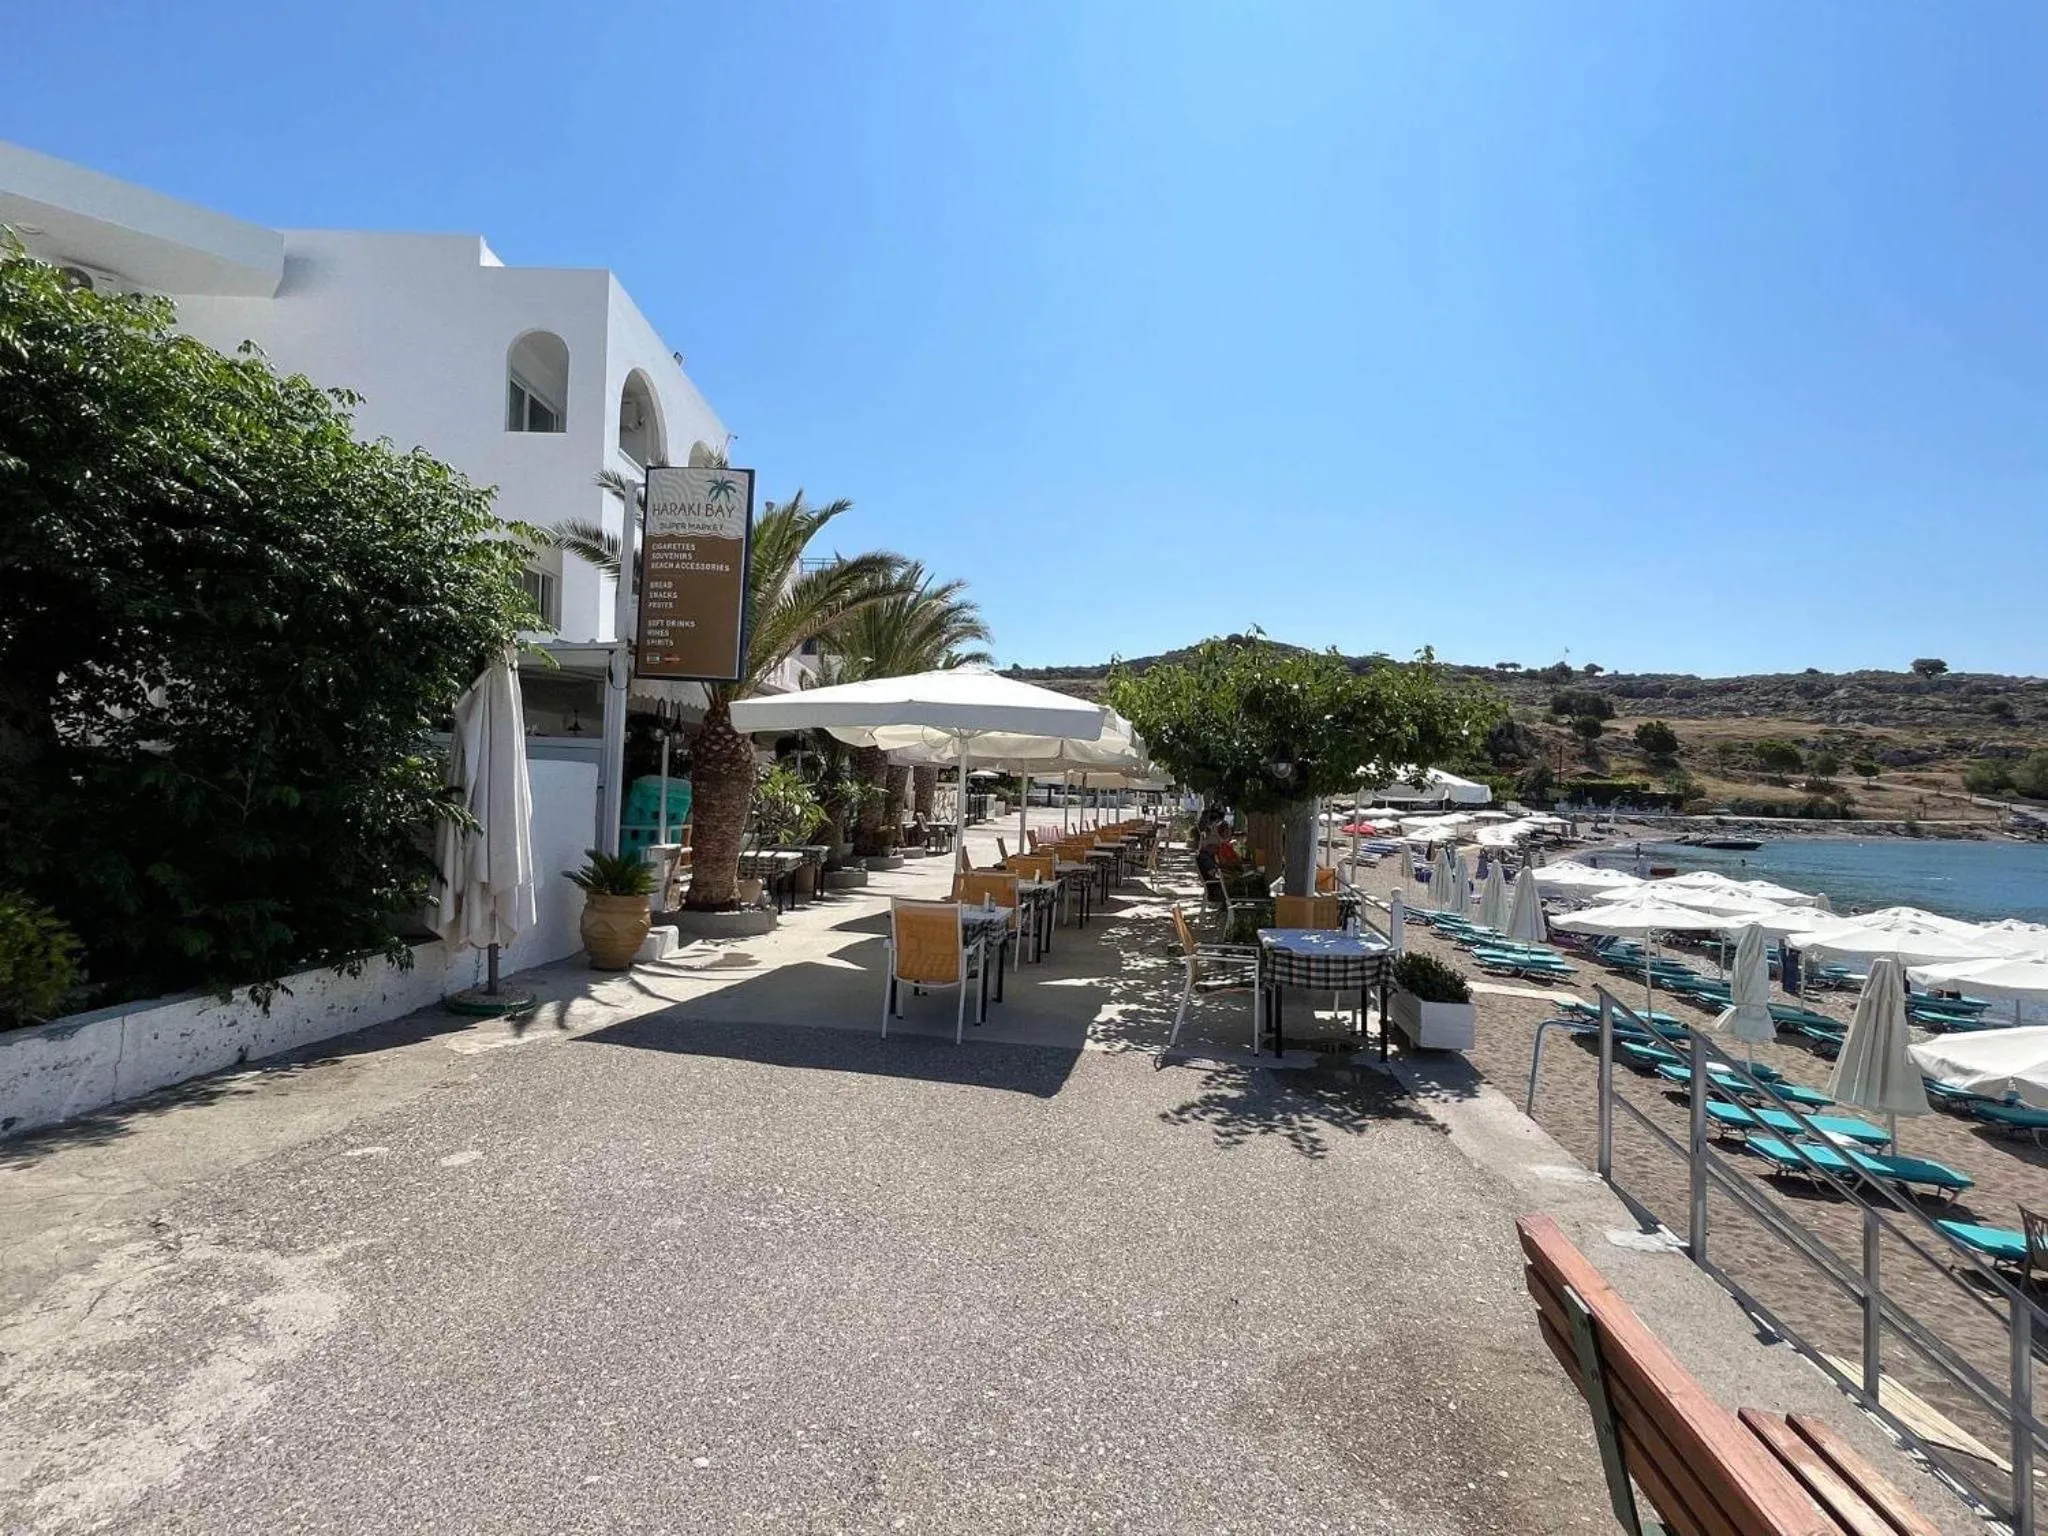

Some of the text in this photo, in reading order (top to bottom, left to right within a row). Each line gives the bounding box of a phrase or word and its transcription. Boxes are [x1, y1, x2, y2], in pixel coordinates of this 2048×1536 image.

[652, 502, 735, 518] HARAKI BAY
[659, 522, 723, 531] SUPER MARKET
[651, 543, 696, 551] CIGARETTES
[651, 552, 693, 560] SOUVENIRS
[651, 561, 730, 572] BEACH ACCESSORIES
[649, 581, 673, 589] BREAD
[648, 591, 678, 599] SNACKS
[666, 620, 696, 628] DRINKS
[646, 639, 674, 647] SPIRITS
